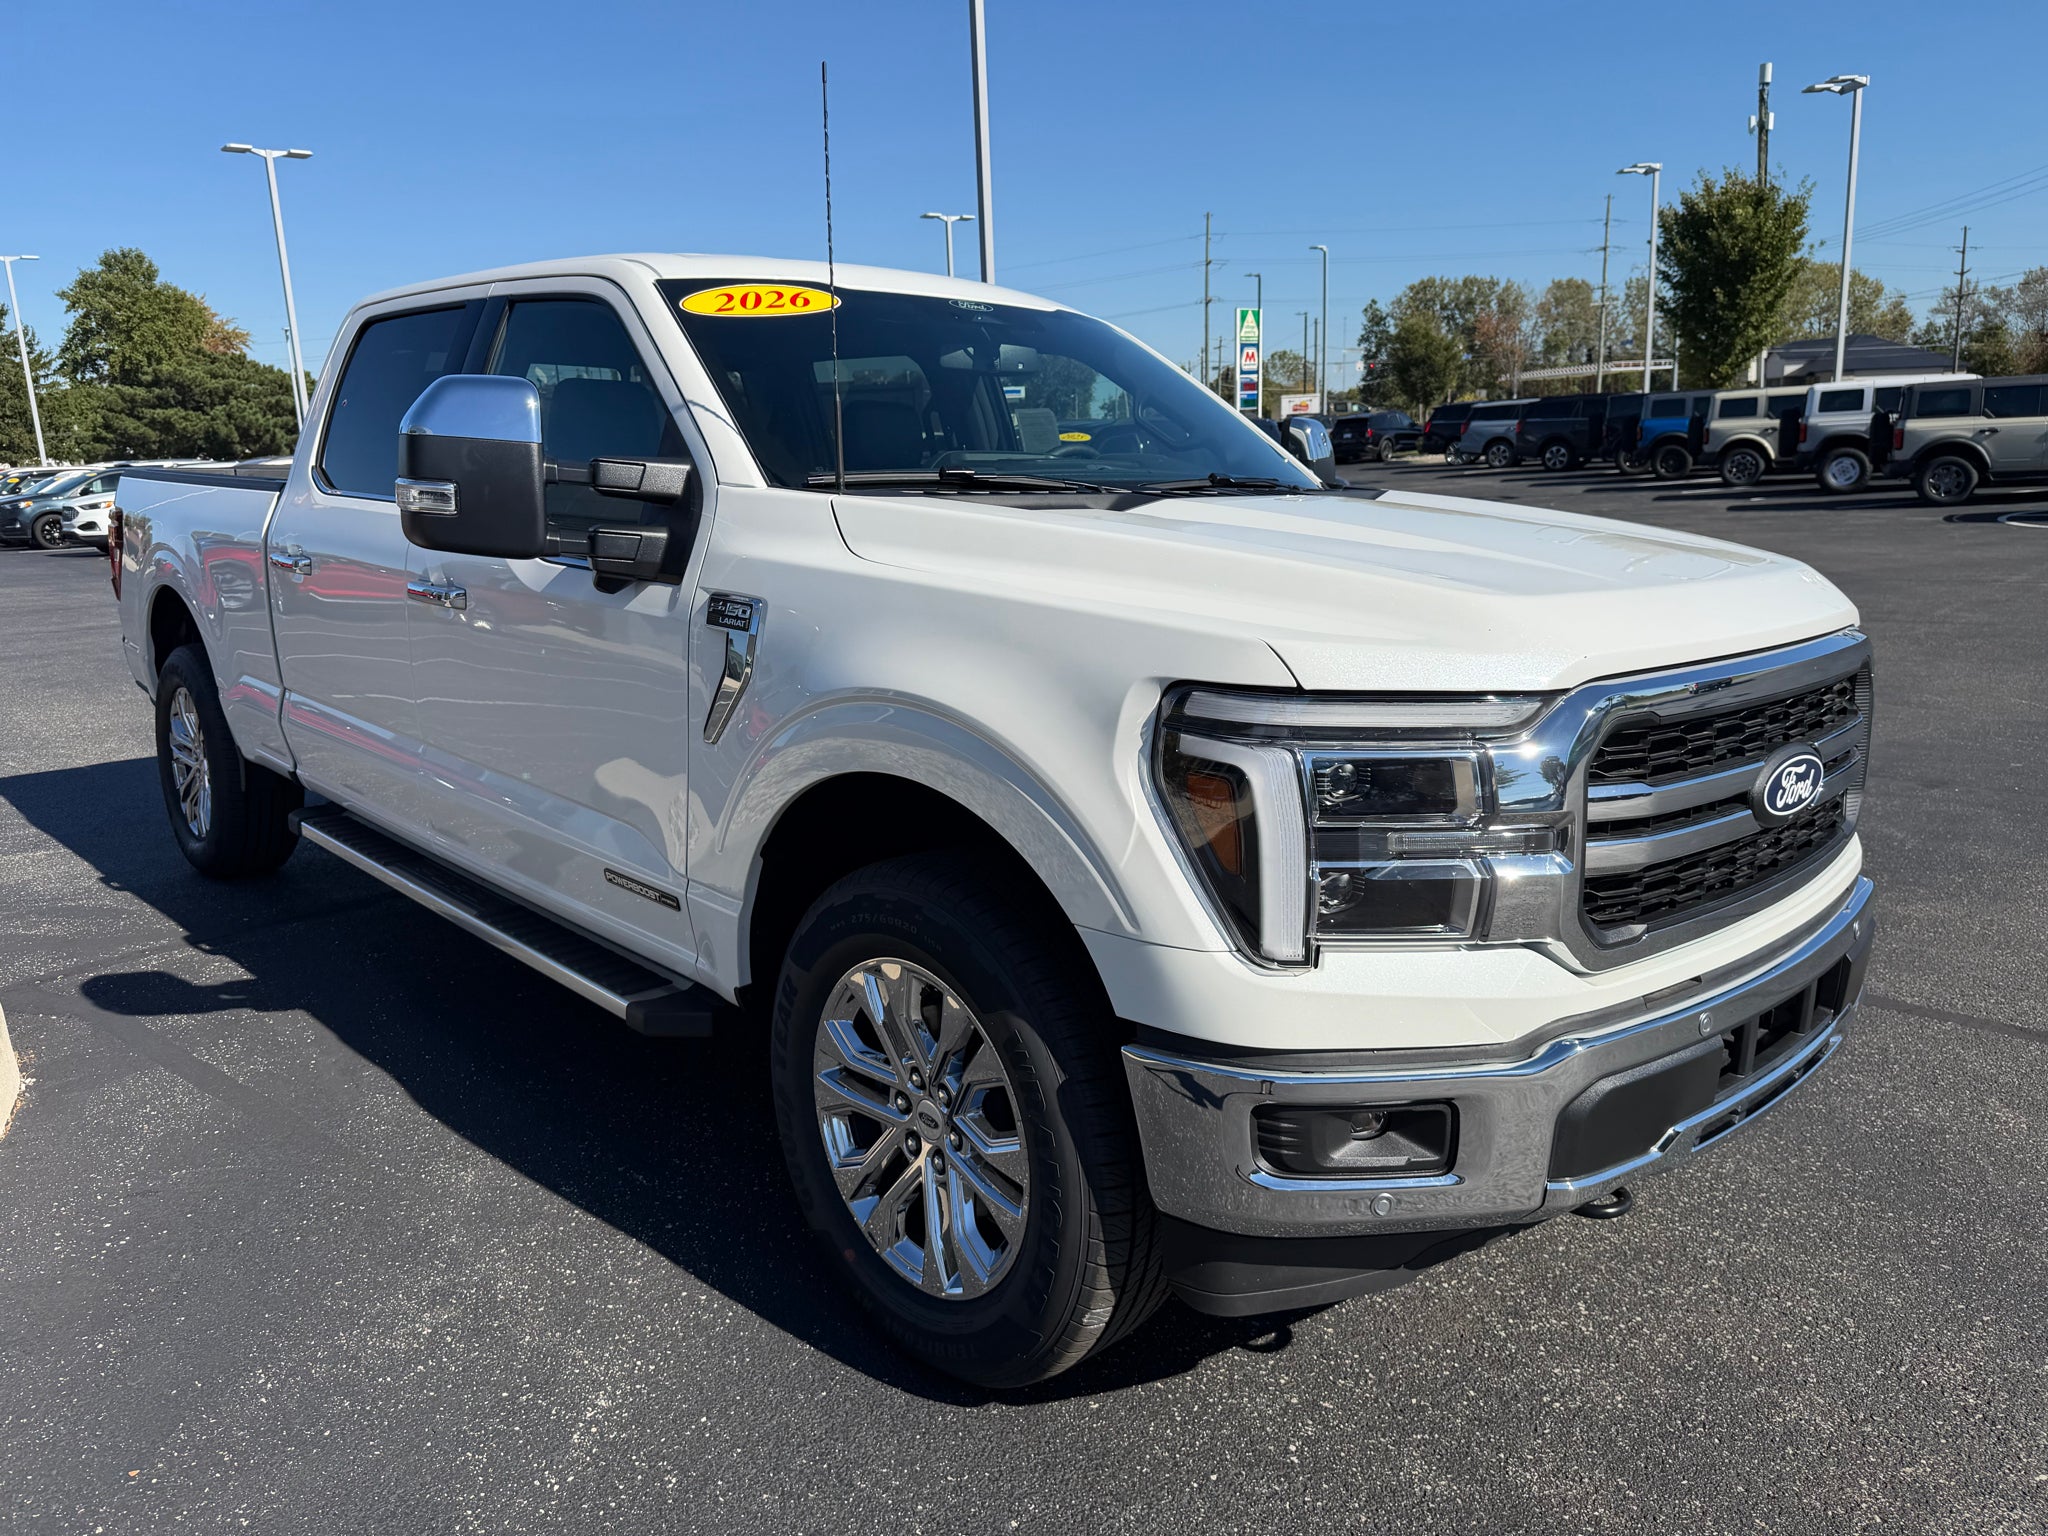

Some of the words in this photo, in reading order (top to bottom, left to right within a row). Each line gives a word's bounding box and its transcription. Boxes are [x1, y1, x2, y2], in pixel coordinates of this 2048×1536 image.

[714, 291, 811, 313] 2026
[719, 616, 746, 628] LARIAT
[1776, 763, 1815, 808] Ford
[606, 871, 660, 902] POWERBOOST
